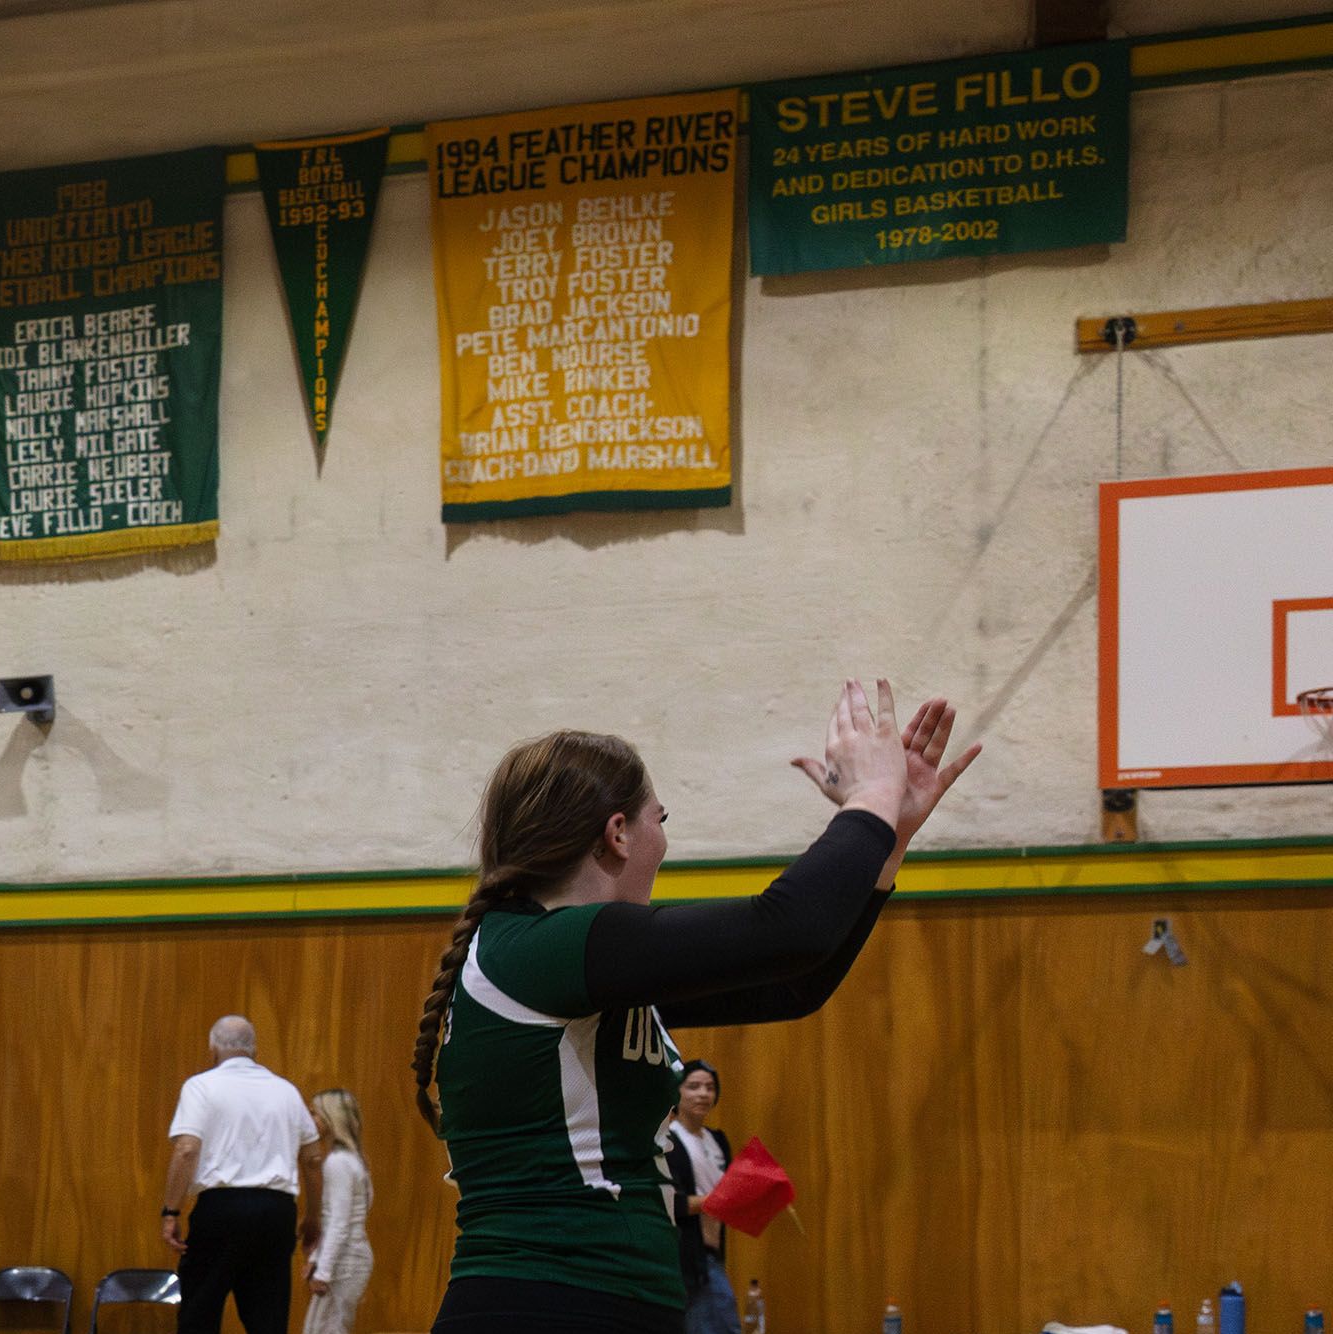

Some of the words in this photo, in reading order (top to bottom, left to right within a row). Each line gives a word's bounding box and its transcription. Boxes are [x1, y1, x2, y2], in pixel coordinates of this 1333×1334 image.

[776, 81, 939, 134] STEVE
[953, 60, 1101, 113] FILLO
[437, 136, 500, 169] 1994
[508, 120, 634, 161] FEATHER
[645, 111, 732, 145] RIVER
[773, 147, 799, 167] 24
[805, 136, 890, 163] YEARS
[895, 131, 932, 153] OF
[938, 122, 1011, 149] HARD
[1015, 115, 1098, 142] WORK
[298, 164, 344, 185] BOYS
[438, 161, 545, 198] LEAGUE
[559, 144, 730, 184] CHAMPIONS
[772, 173, 824, 197] AND
[832, 156, 985, 191] DEDICATION
[988, 153, 1022, 174] TO
[1030, 146, 1107, 171] D.H.S.
[278, 180, 365, 207] BASKETBALL
[479, 202, 563, 232] JASON
[577, 192, 676, 223] BEHLKE
[810, 199, 888, 225] GIRLS
[894, 181, 1064, 216] BASKETBALL
[7, 197, 153, 247] UNDEFEATED
[279, 201, 365, 226] 1992-93
[50, 237, 120, 271] RIVER
[129, 220, 214, 261] LEAGUE
[493, 227, 557, 255] JOEY
[572, 219, 663, 247] BROWN
[875, 220, 999, 250] 1978-2002
[93, 251, 220, 297] CHAMPIONS
[483, 250, 563, 281] TERRY
[576, 241, 674, 272] FOSTER
[496, 276, 558, 303] TROY
[567, 267, 666, 297] FOSTER
[15, 315, 75, 344] ERICA
[84, 304, 157, 338] BEARSE
[488, 300, 552, 330] BRAD
[562, 291, 671, 321] JACKSON
[38, 322, 191, 364] BLANKENBILLER
[456, 329, 518, 357] PETE
[527, 313, 700, 349] MARCANTONIO
[15, 366, 75, 391] TAMMY
[85, 352, 157, 384] FOSTER
[487, 352, 536, 379] BEN
[551, 340, 647, 371] NOURSE
[5, 387, 75, 417] LAURIE
[86, 375, 170, 407] HOPKINS
[487, 372, 549, 403] MIKE
[6, 414, 62, 441] MOLLY
[75, 401, 171, 433] MARSHALL
[538, 415, 704, 449] HENDRICKSON
[7, 439, 64, 465] LESLY
[75, 426, 160, 458] MILGATE
[587, 444, 718, 470] MARSHALL
[8, 461, 78, 490] CARRIE
[89, 452, 172, 482] NEUBERT
[10, 486, 78, 513] LAURIE
[89, 477, 162, 506] SIELER
[43, 507, 102, 534] FILLO
[127, 500, 182, 526] COACH
